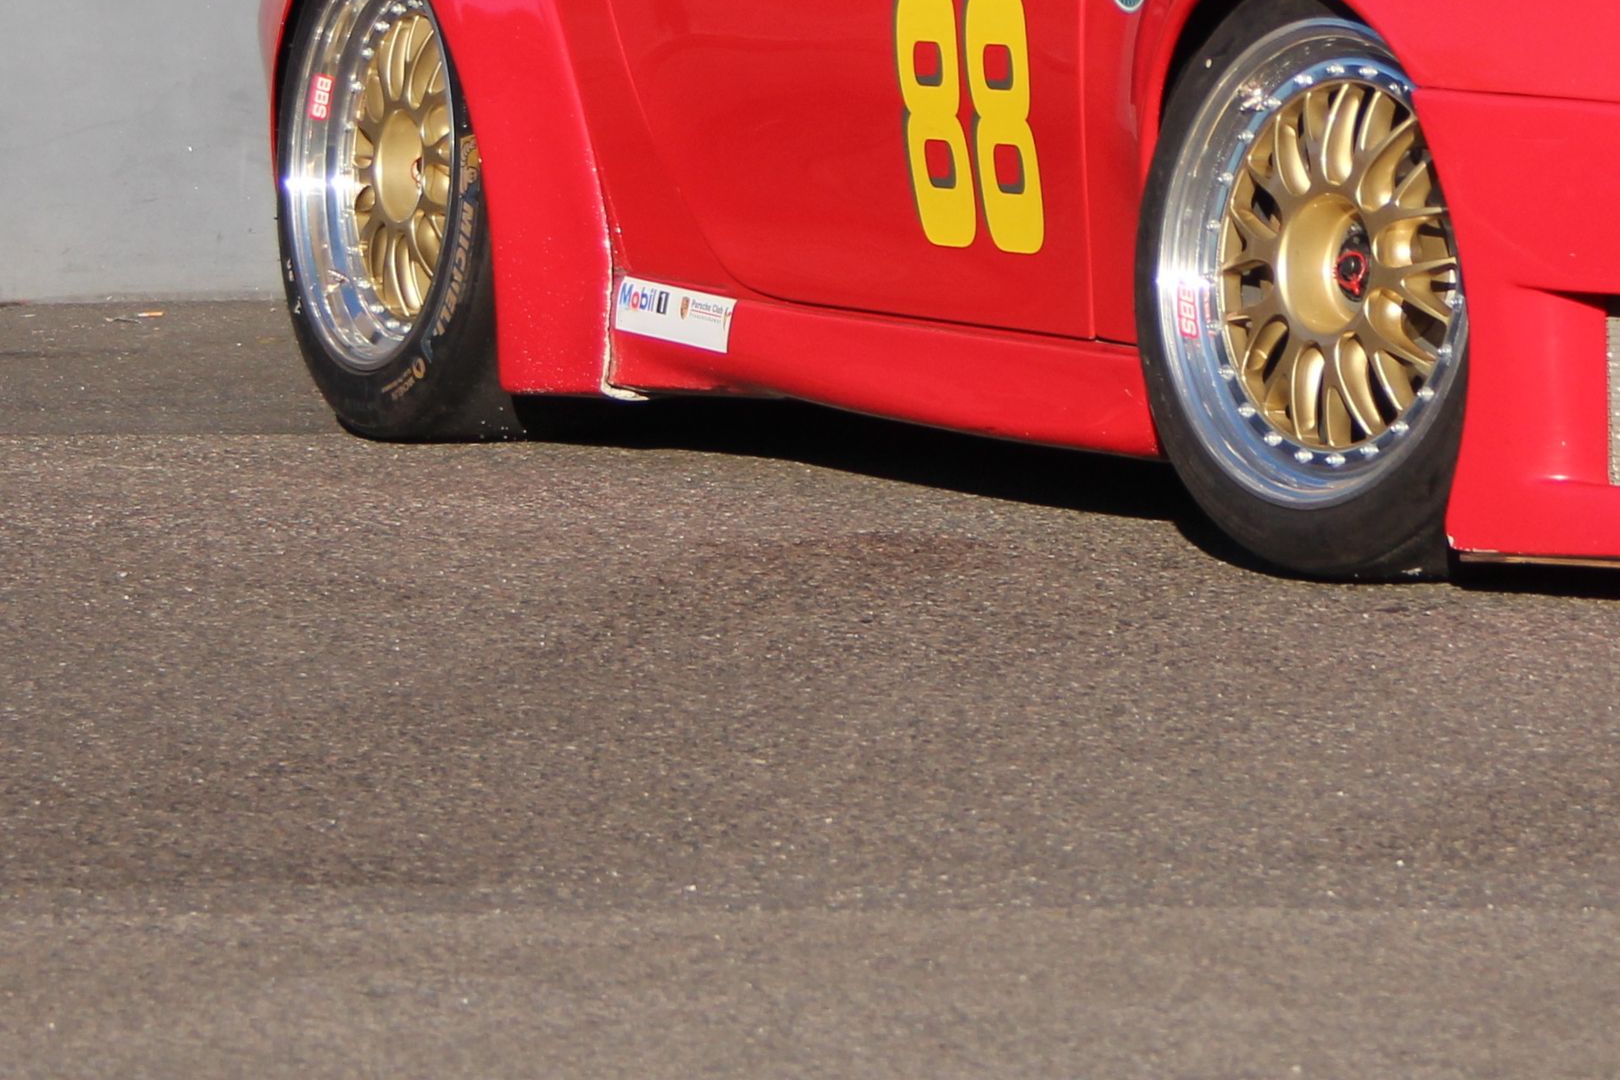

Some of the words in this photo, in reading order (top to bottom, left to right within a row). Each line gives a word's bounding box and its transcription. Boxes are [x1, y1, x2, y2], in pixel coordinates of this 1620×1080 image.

[312, 76, 332, 119] BBS
[433, 201, 474, 336] MICHELI
[620, 282, 656, 312] Mobil
[657, 291, 668, 313] 1
